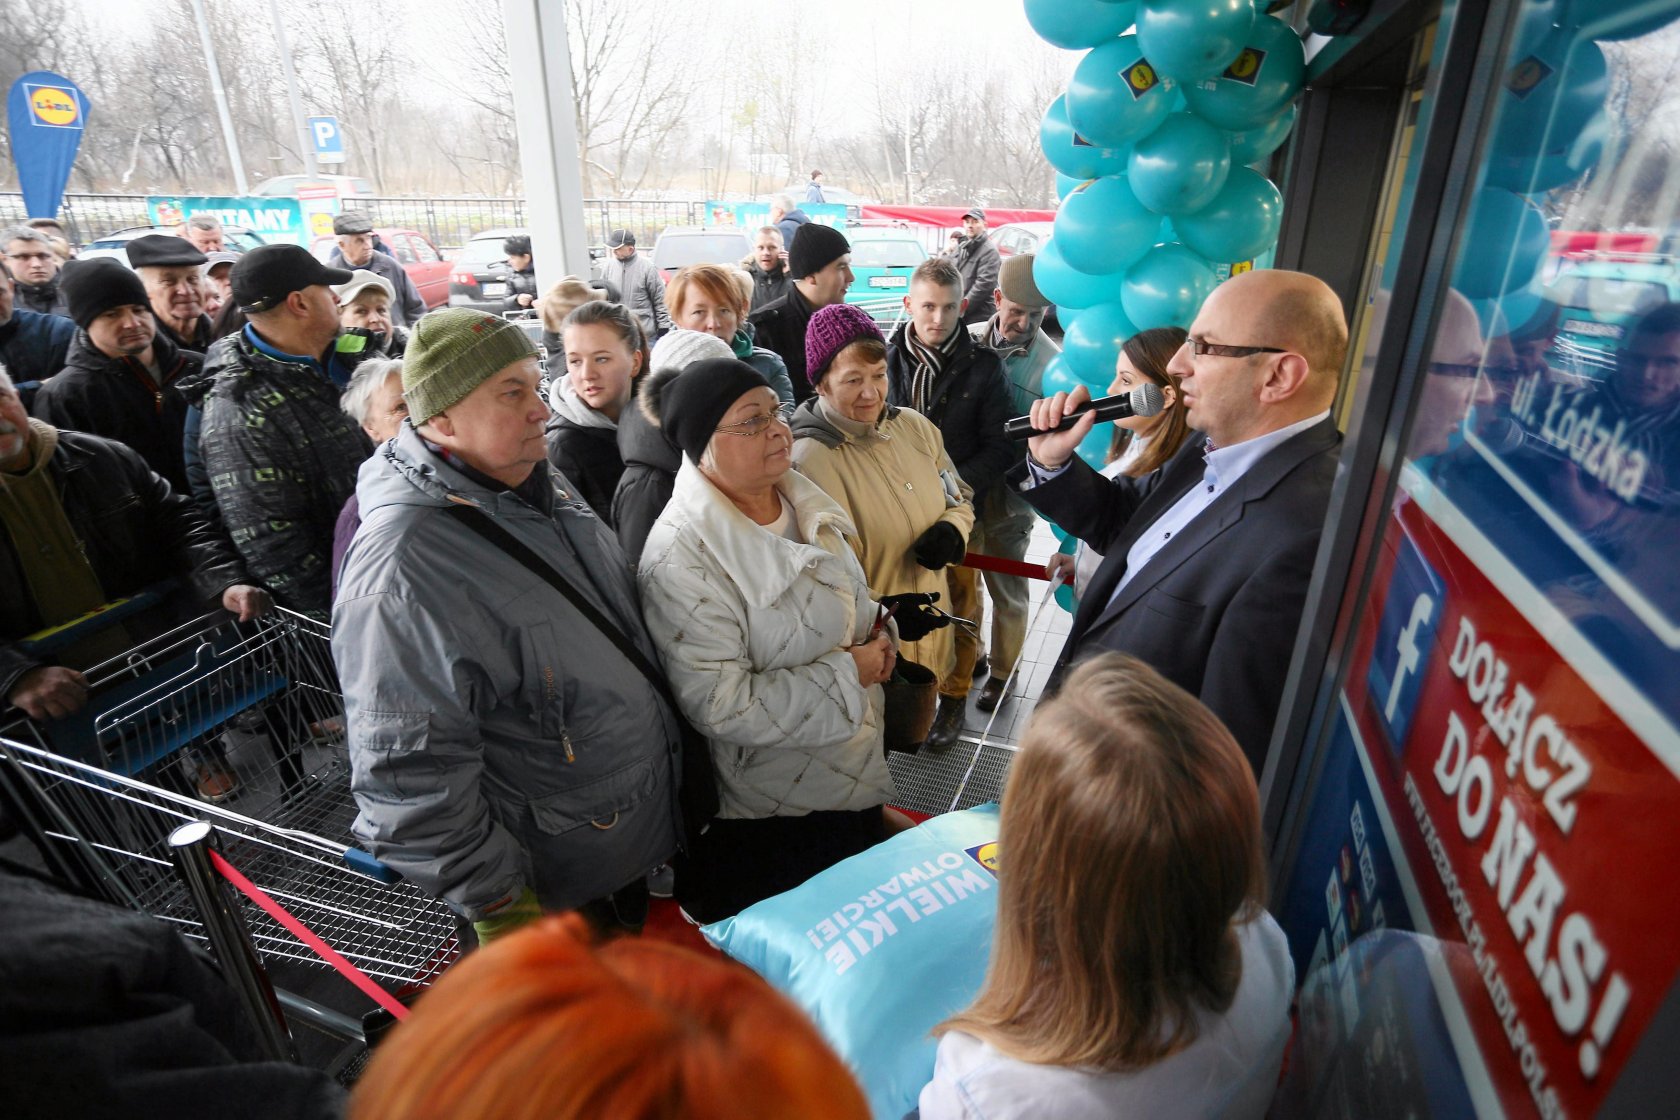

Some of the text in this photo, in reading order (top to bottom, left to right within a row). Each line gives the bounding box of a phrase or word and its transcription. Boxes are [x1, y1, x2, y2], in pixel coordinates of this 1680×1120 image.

[313, 121, 335, 148] P
[1510, 370, 1648, 503] ul. Łódzka
[1449, 616, 1592, 834] DOŁĄCZ
[806, 852, 964, 950] OTWARCIE!
[824, 869, 991, 976] WIELKIE
[1433, 710, 1631, 1080] DO NAS!
